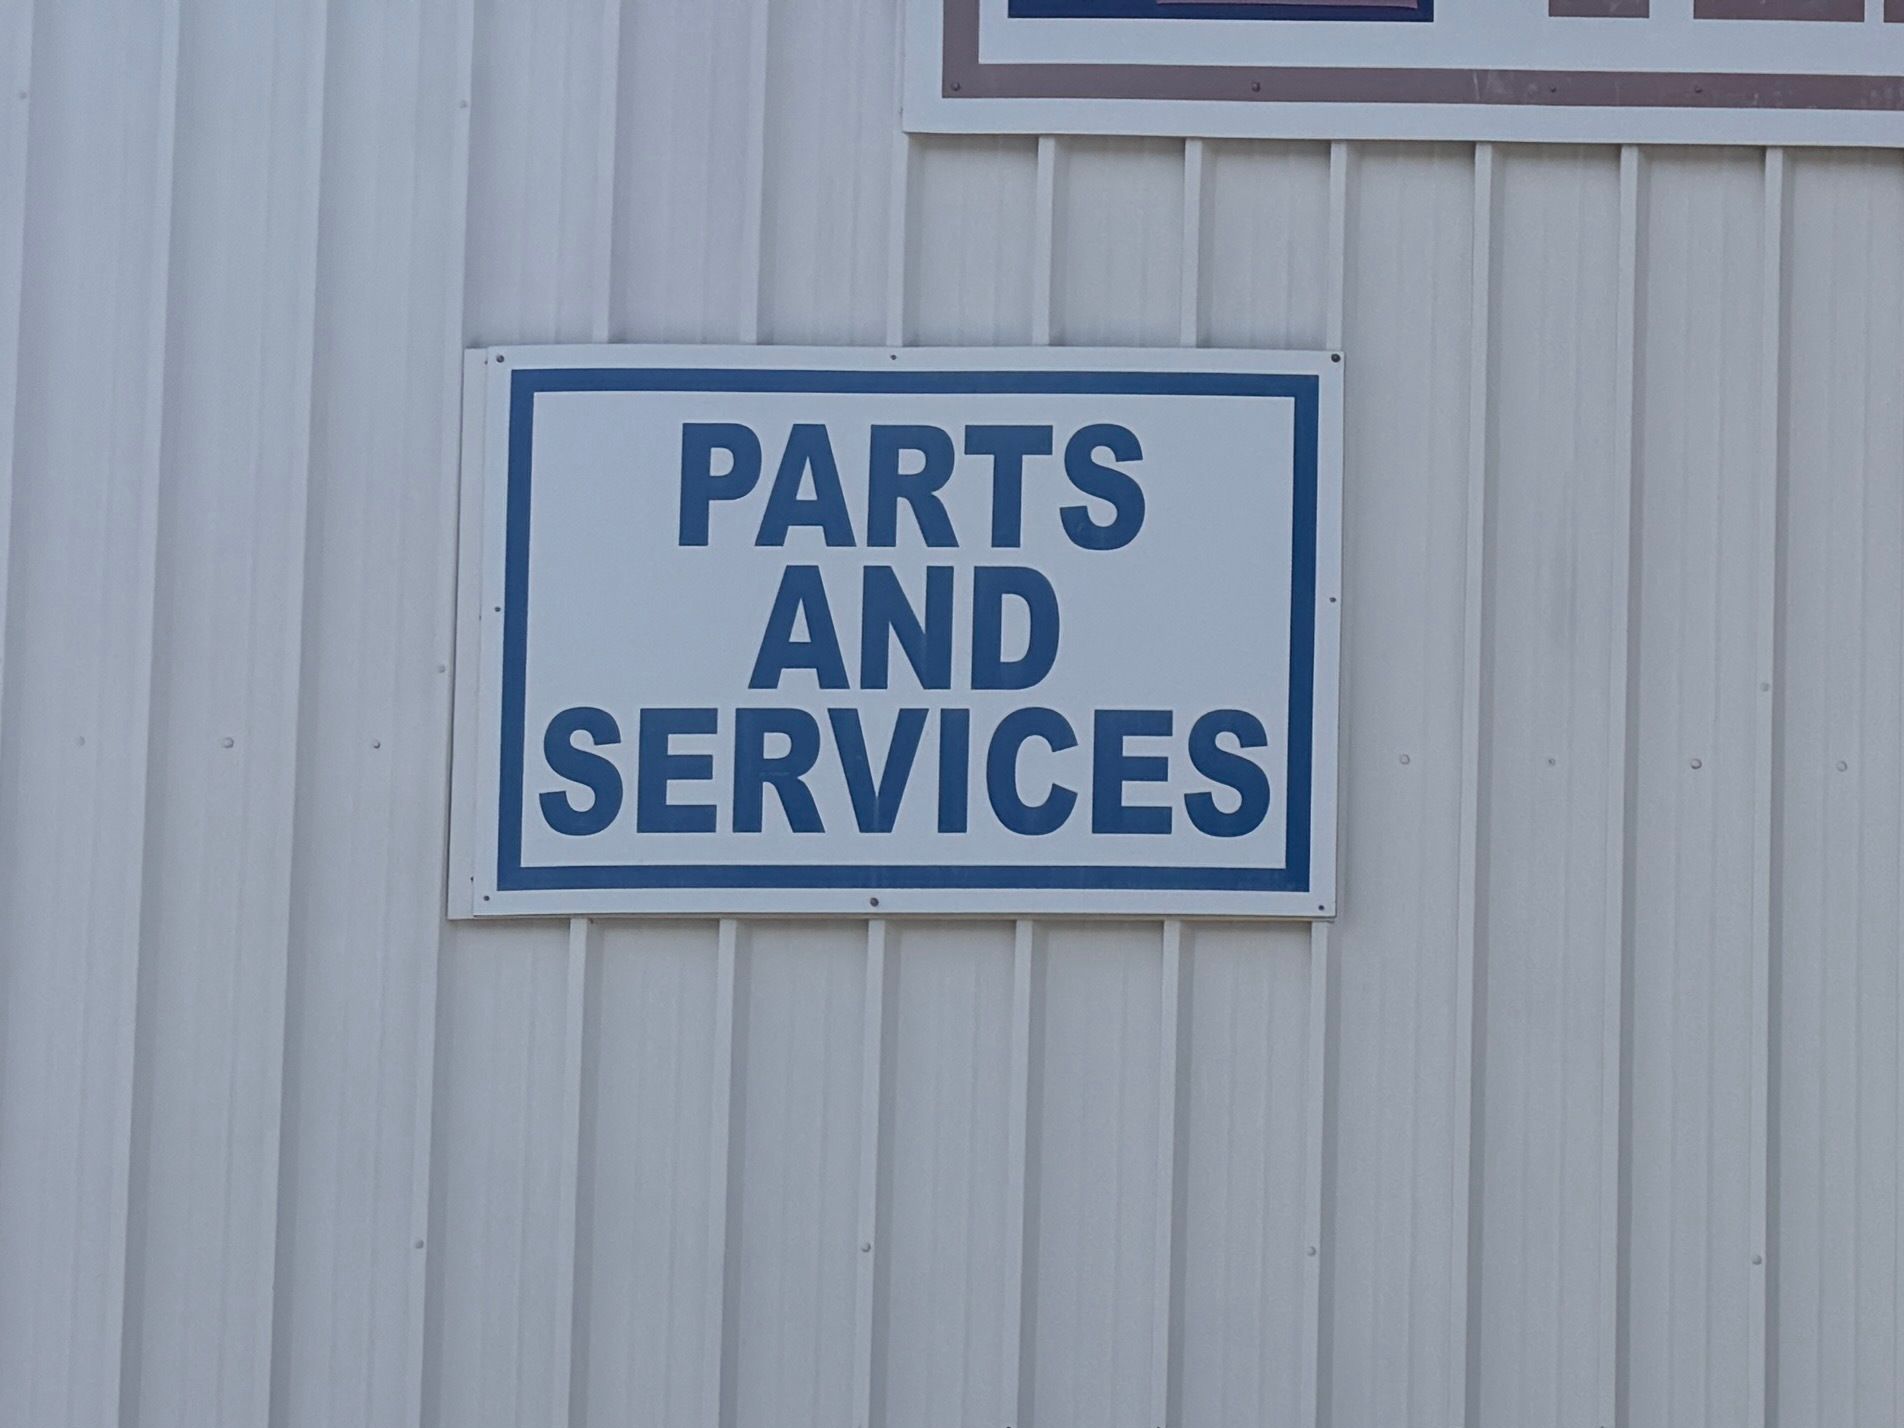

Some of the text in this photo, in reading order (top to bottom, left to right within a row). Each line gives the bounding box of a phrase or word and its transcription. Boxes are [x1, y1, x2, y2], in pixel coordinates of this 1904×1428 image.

[678, 422, 1146, 551] PARTS
[747, 564, 1061, 691] AND
[538, 705, 1271, 838] SERVICES
